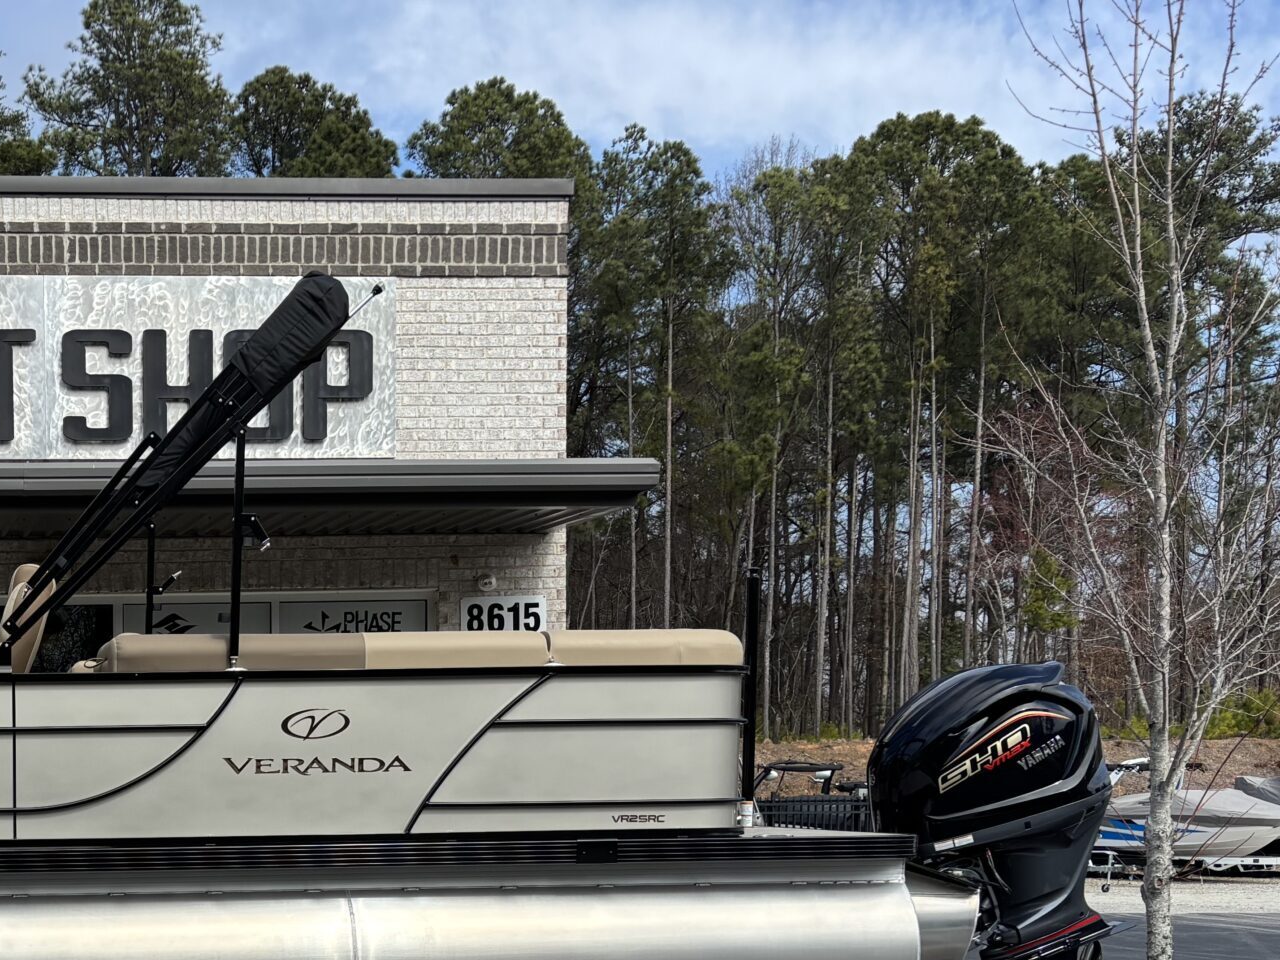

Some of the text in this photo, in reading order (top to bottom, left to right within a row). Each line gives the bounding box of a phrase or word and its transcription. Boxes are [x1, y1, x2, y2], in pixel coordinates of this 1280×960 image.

[342, 610, 403, 633] PHASE
[466, 602, 541, 632] 8615
[222, 755, 412, 776] VERANDA
[1017, 734, 1067, 771] YAMAHA
